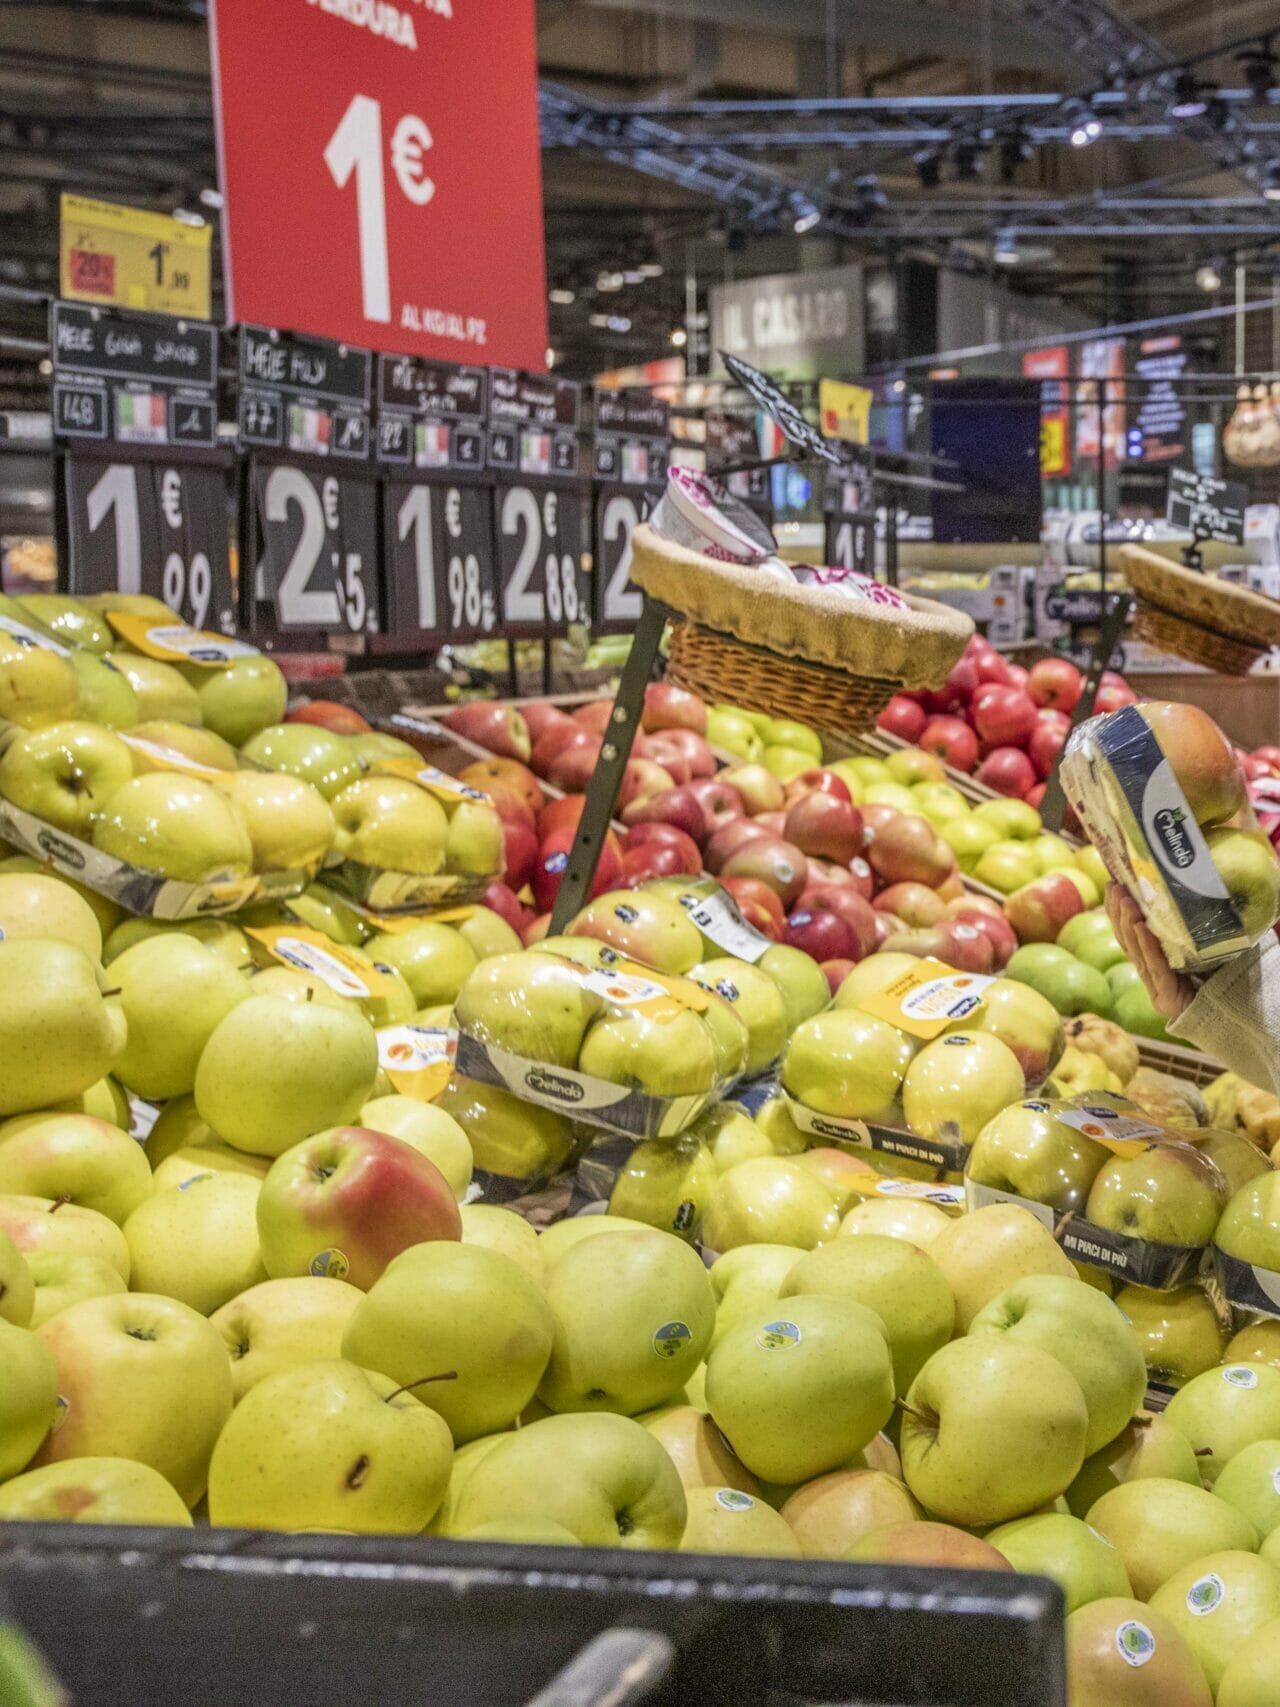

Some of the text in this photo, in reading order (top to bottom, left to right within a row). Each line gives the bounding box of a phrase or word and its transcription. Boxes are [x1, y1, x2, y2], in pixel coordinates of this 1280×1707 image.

[324, 94, 435, 323] 1 €
[398, 485, 436, 629] 1
[503, 486, 545, 621] 2
[1157, 811, 1191, 868] Melinda
[527, 1072, 582, 1099] Melinda
[1064, 1234, 1128, 1268] MI PIACI DI PIÙ
